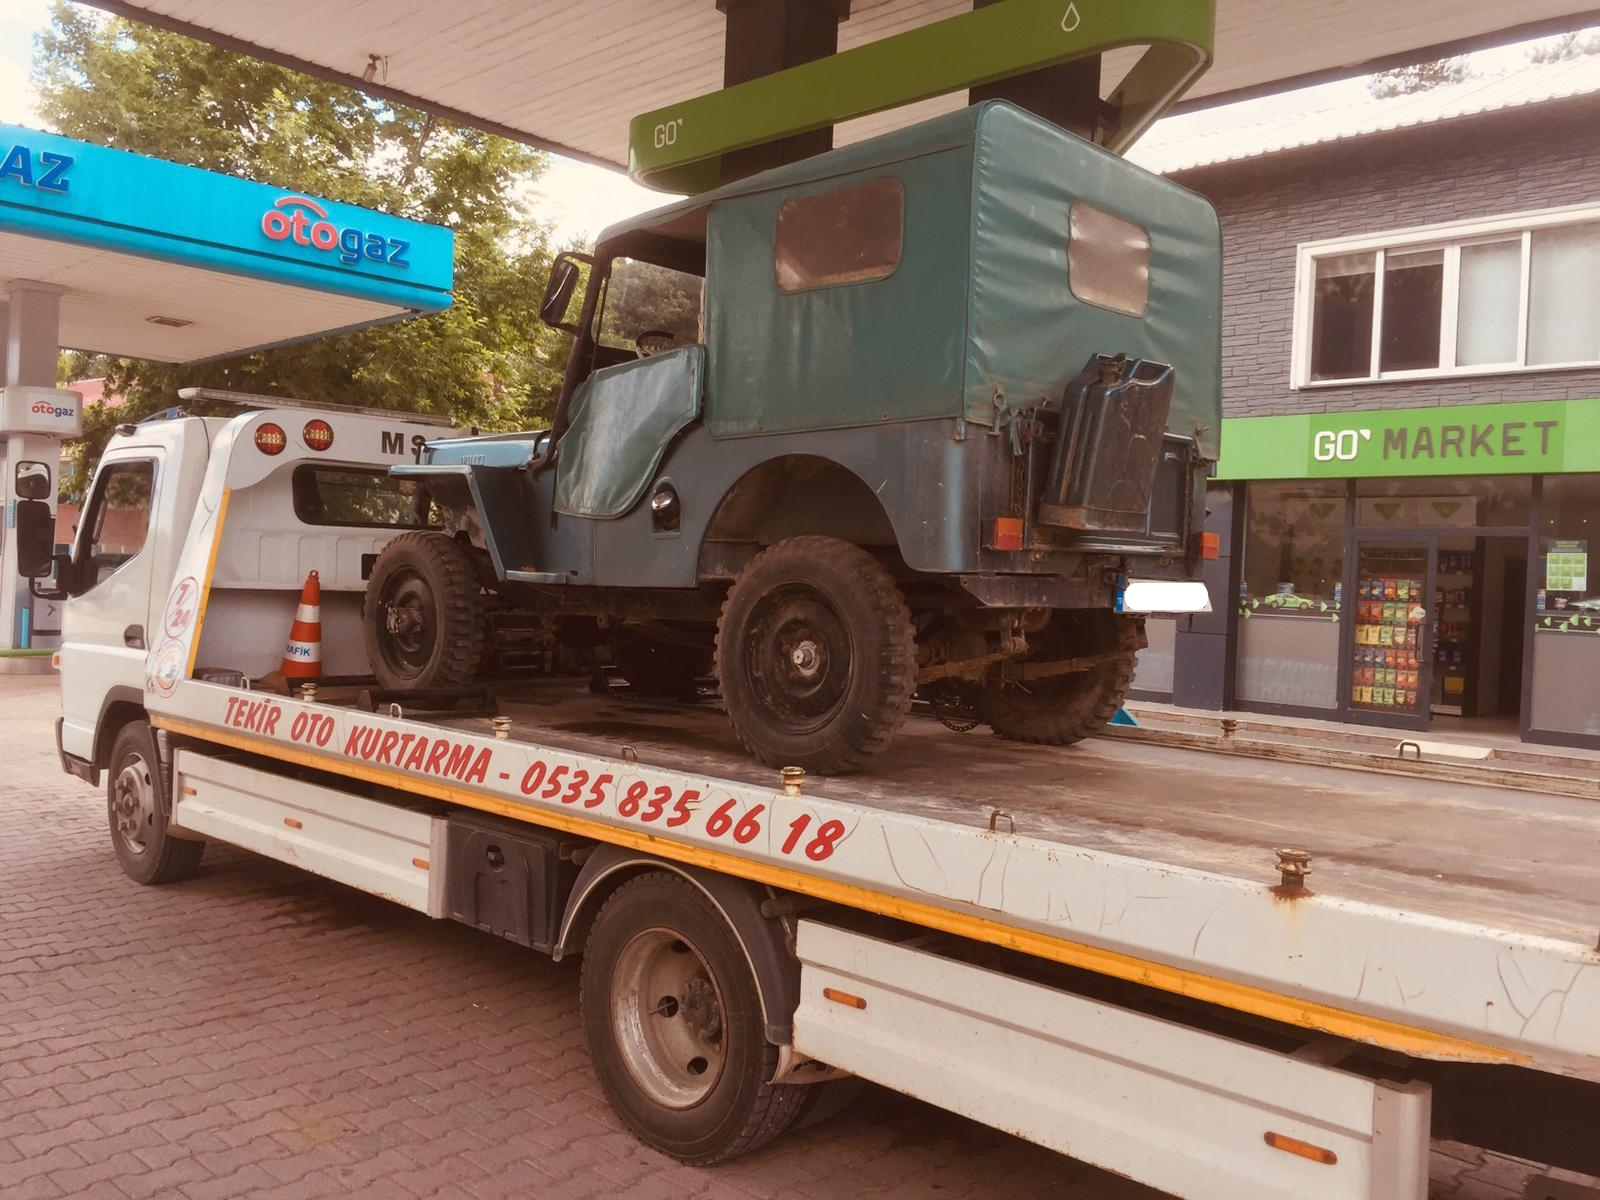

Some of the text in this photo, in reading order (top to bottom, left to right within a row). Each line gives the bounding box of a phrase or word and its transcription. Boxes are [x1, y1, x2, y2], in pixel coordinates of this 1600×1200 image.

[261, 207, 411, 269] otogaz
[31, 404, 75, 418] otogaz
[1383, 420, 1559, 460] MARKET
[224, 696, 281, 736] TEKİR
[290, 711, 335, 747] OTO
[343, 725, 493, 784] KURTARMA
[520, 760, 614, 809] 0535
[618, 780, 700, 828] 835
[705, 798, 766, 845] 66
[781, 813, 846, 862] 18
